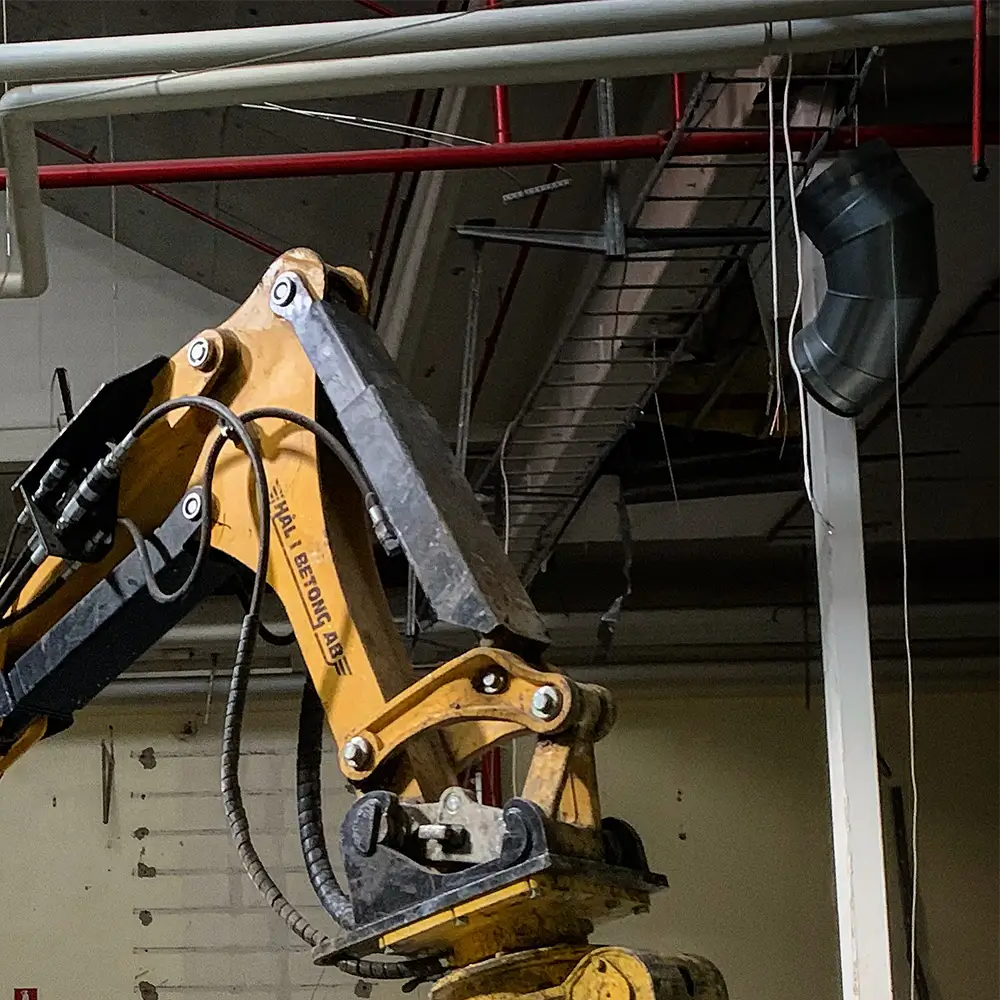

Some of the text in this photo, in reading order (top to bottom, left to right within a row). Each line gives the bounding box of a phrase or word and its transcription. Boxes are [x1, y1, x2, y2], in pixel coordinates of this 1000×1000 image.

[273, 500, 345, 659] HÅL I BETONG AB
